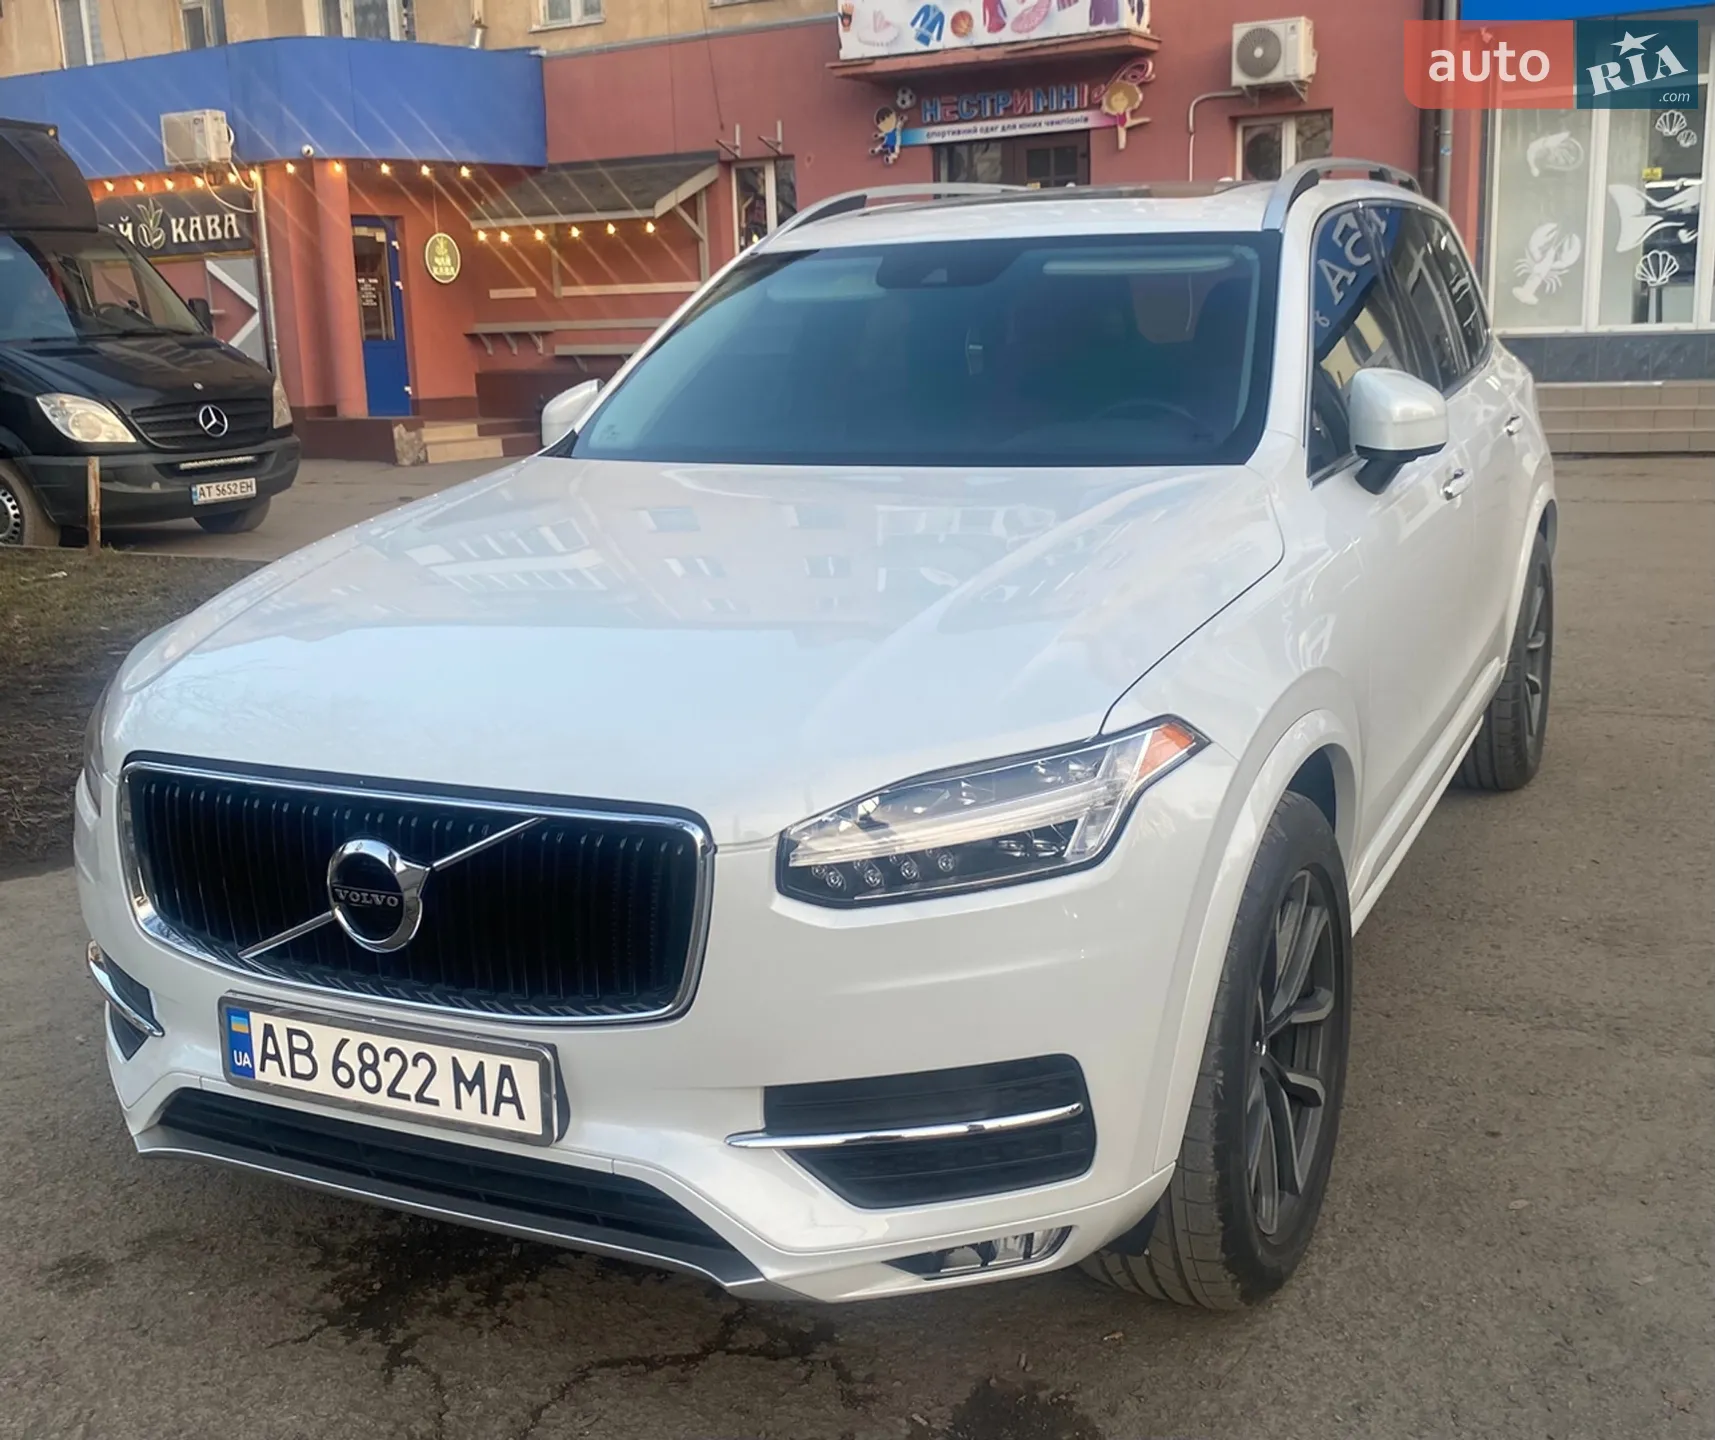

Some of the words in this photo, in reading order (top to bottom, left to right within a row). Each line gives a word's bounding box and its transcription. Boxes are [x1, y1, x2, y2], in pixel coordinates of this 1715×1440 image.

[171, 213, 242, 243] КАВА
[334, 888, 399, 907] VOLVO
[233, 1049, 252, 1069] UA
[258, 1022, 319, 1082] AB
[331, 1037, 440, 1107] 6822
[451, 1055, 526, 1122] MA
